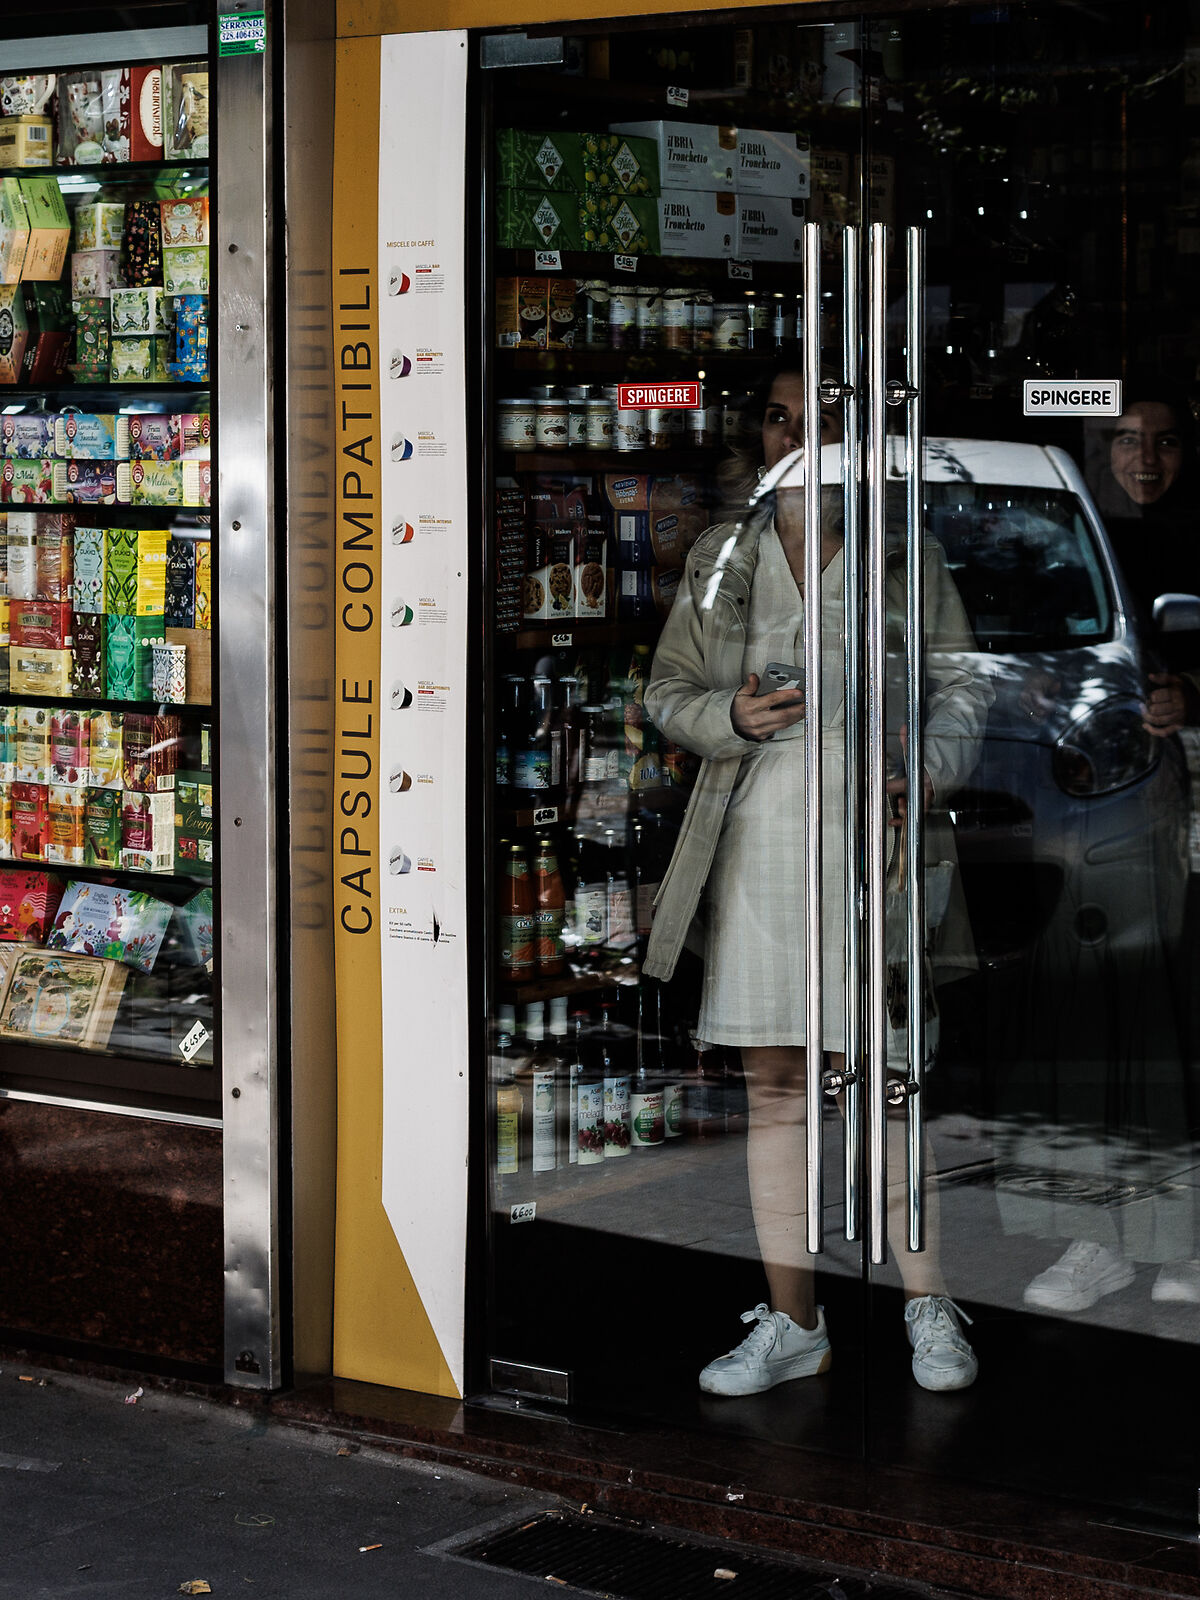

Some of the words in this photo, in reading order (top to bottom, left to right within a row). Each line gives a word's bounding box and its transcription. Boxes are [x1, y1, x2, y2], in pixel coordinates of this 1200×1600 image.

[220, 19, 264, 30] SERRANDE
[222, 28, 264, 41] 328.4064382
[668, 150, 708, 164] Tronchetto
[740, 156, 780, 170] Tronchetto
[664, 218, 706, 231] Tronchetto
[742, 223, 778, 236] Tronchetto
[386, 240, 410, 248] MISCELE
[627, 388, 690, 404] SPINGERE
[1030, 390, 1112, 406] SPINGERE
[340, 268, 374, 632] COMPATIBILI
[340, 678, 374, 934] CAPSULE
